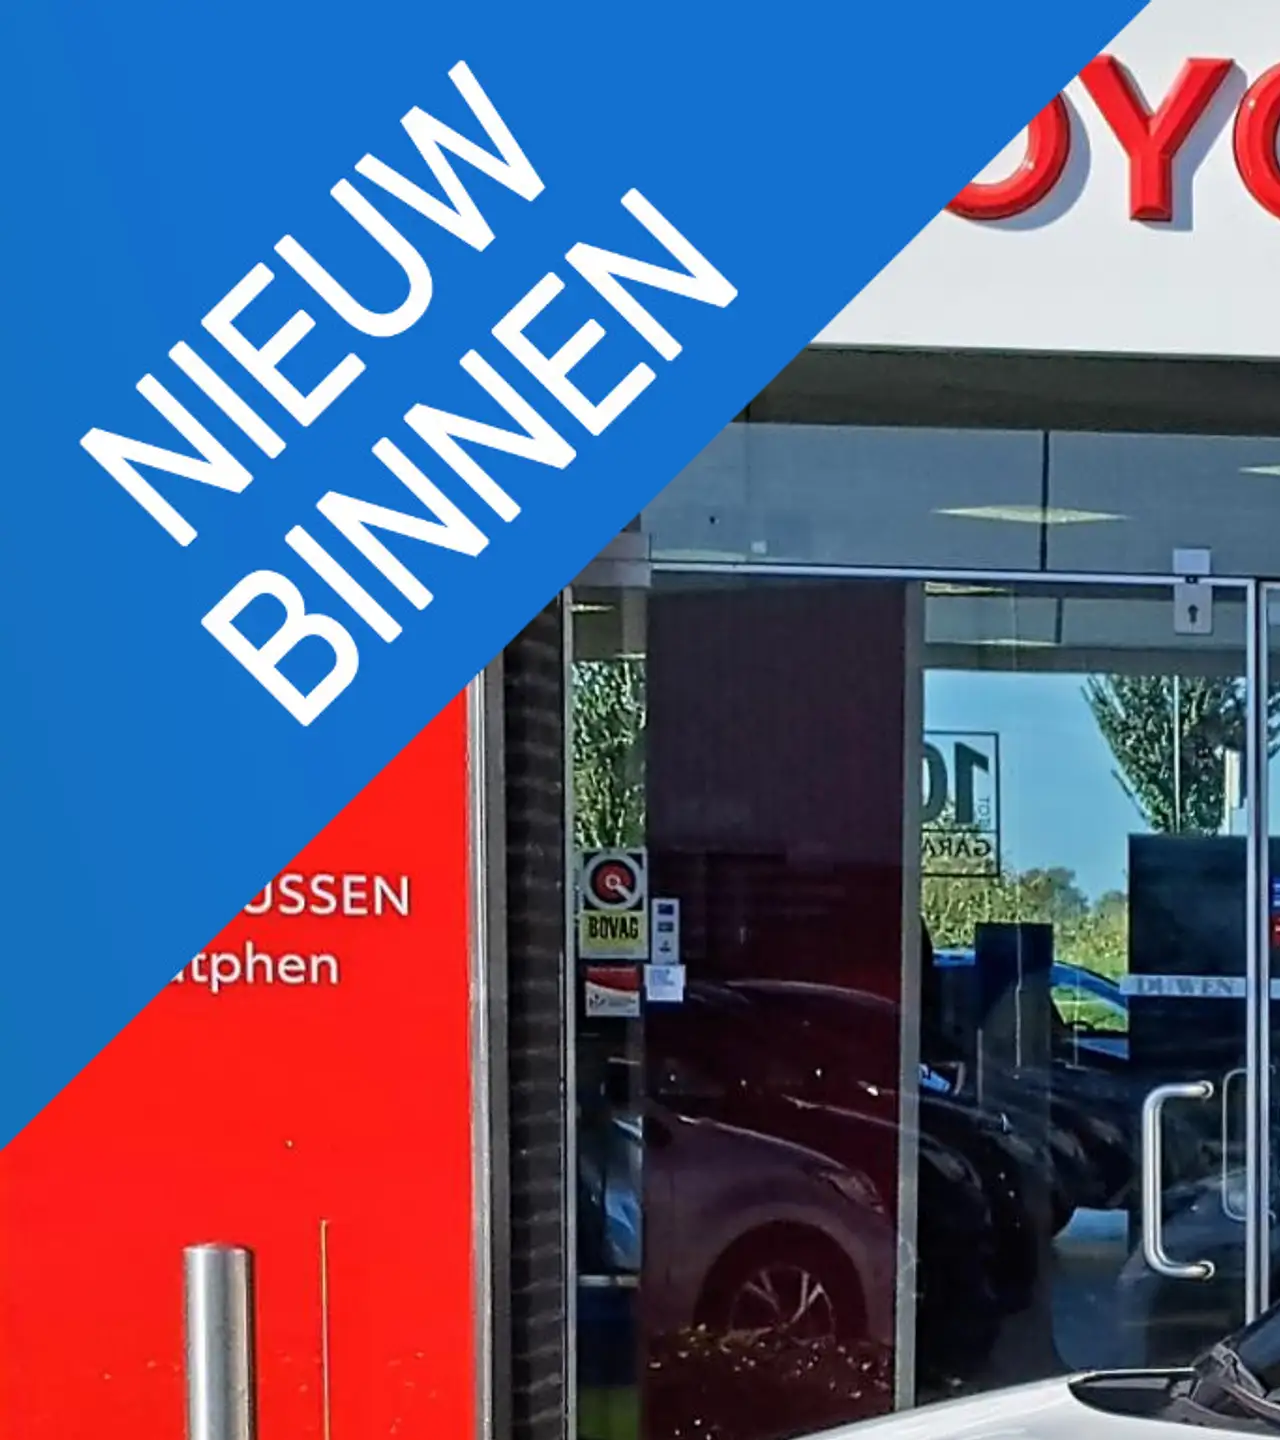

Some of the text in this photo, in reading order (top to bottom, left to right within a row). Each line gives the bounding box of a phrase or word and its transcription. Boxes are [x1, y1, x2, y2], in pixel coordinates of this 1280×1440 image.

[588, 915, 640, 940] BOVAG
[171, 940, 340, 994] tphen
[1136, 977, 1234, 996] DUWEN
